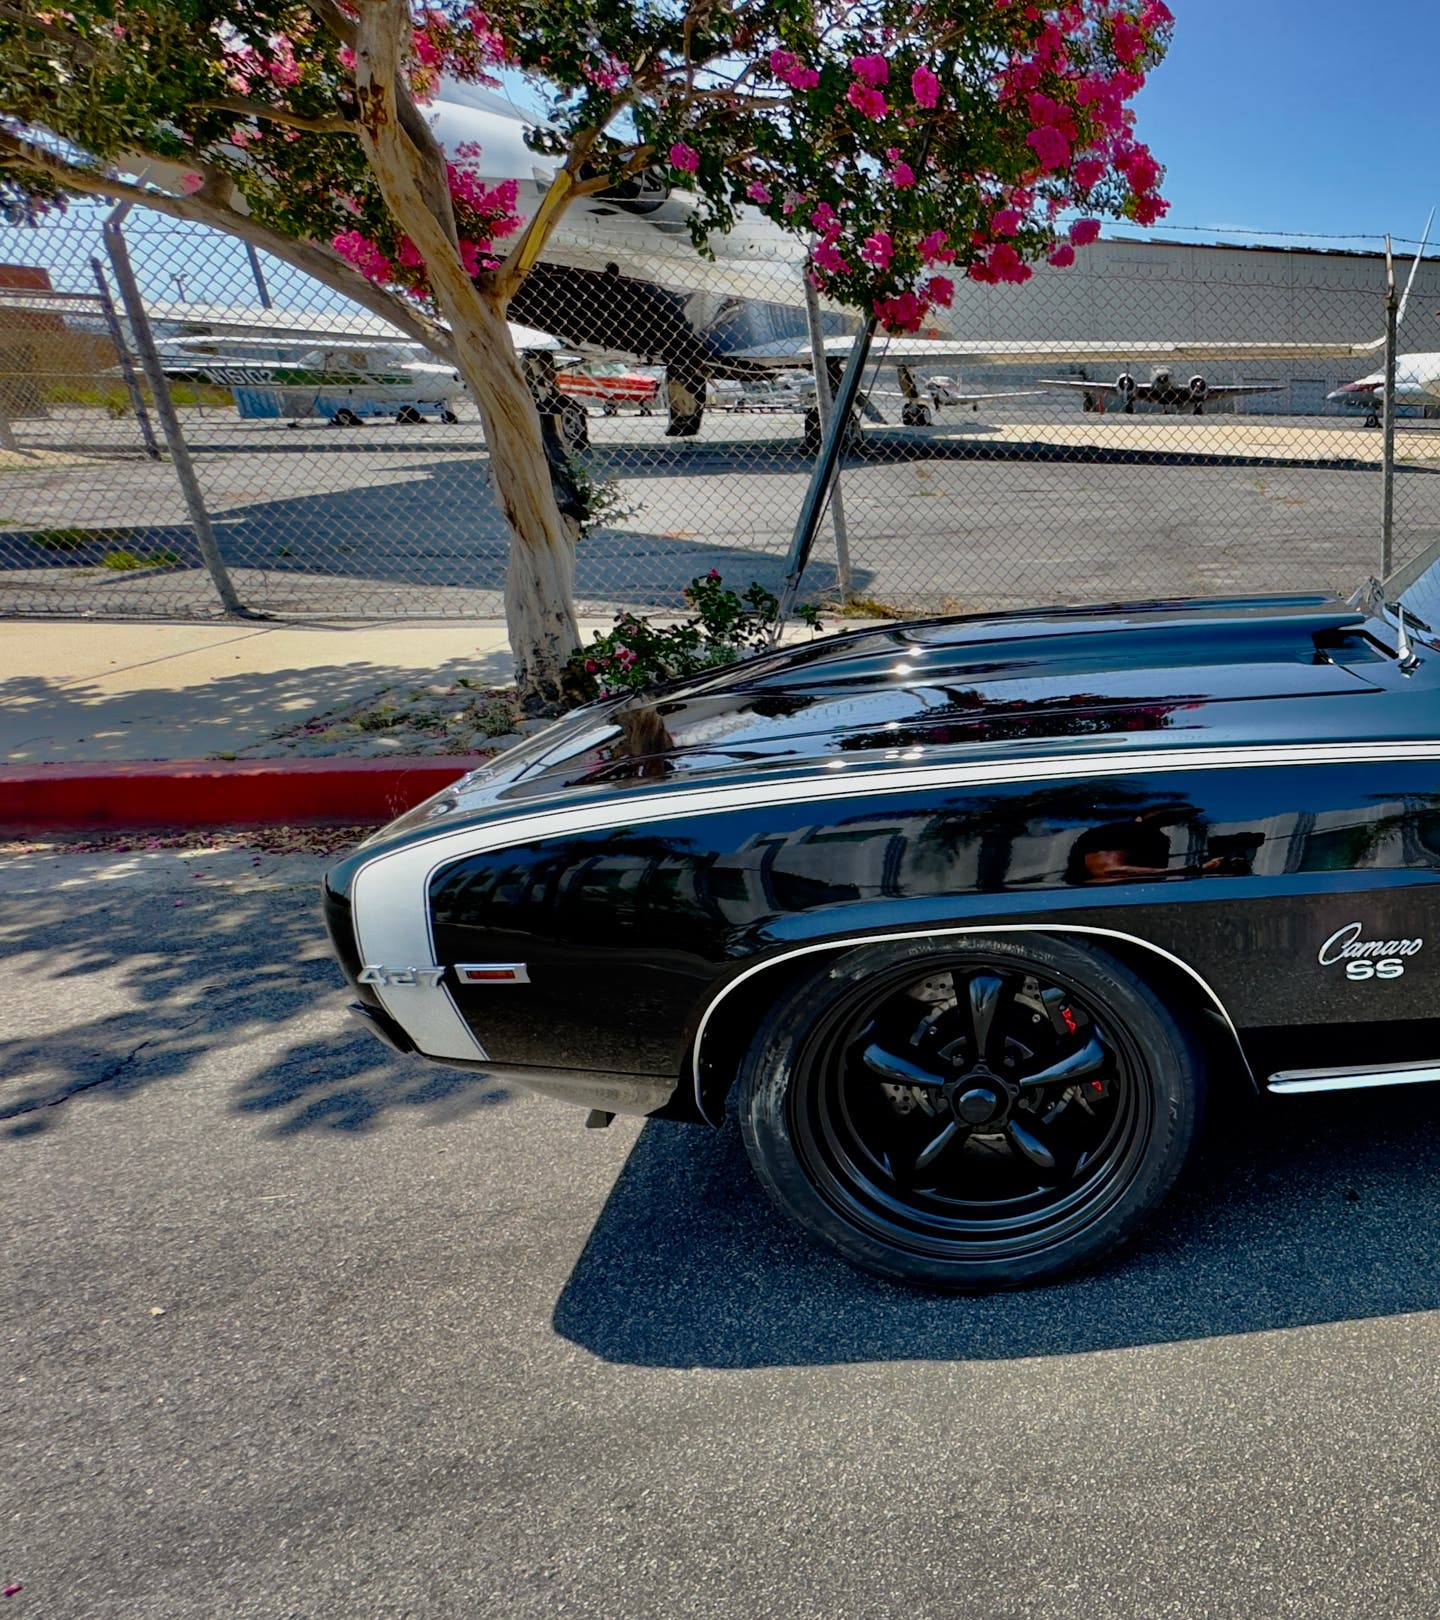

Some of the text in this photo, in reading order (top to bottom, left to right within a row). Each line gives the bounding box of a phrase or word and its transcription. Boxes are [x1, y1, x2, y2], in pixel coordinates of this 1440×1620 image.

[1318, 922, 1423, 966] Camaro
[357, 964, 446, 987] 427
[1346, 958, 1404, 980] SS
